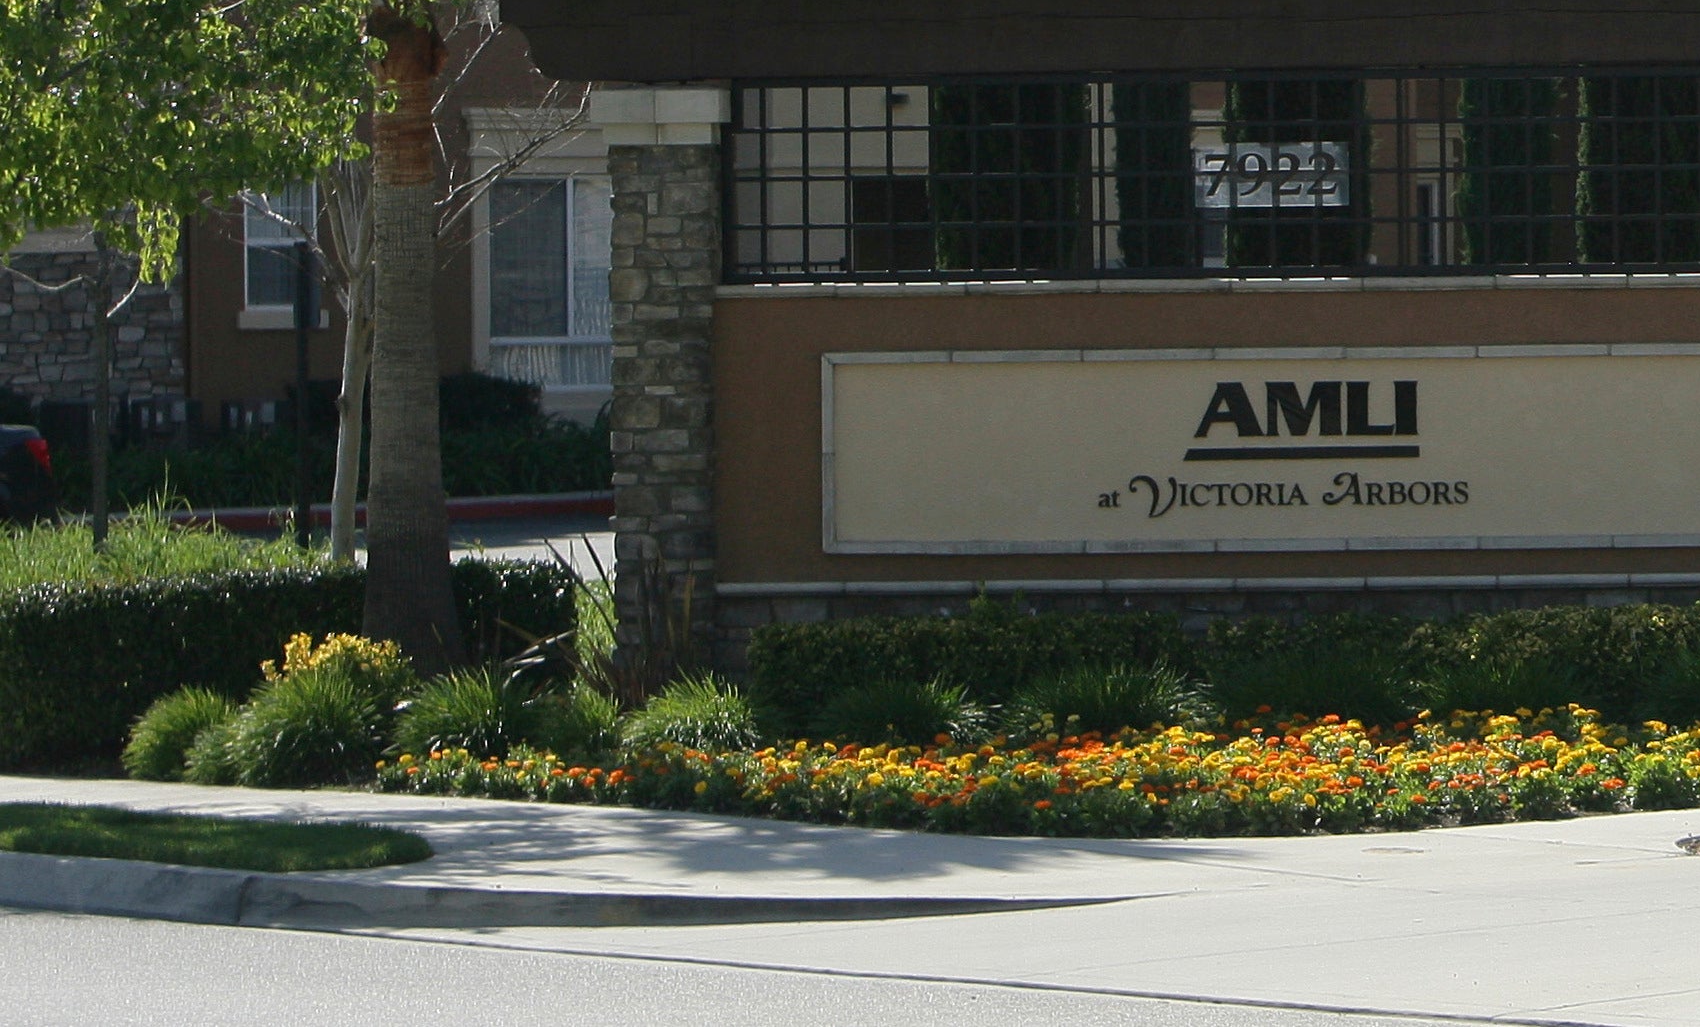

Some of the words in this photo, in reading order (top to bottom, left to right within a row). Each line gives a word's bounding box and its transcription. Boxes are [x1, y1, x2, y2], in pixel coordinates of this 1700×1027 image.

[1204, 151, 1338, 197] 7922
[1193, 380, 1419, 438] AMLI
[1098, 490, 1120, 508] at
[1129, 475, 1308, 518] VICTORIA
[1322, 472, 1470, 506] ARBORS
